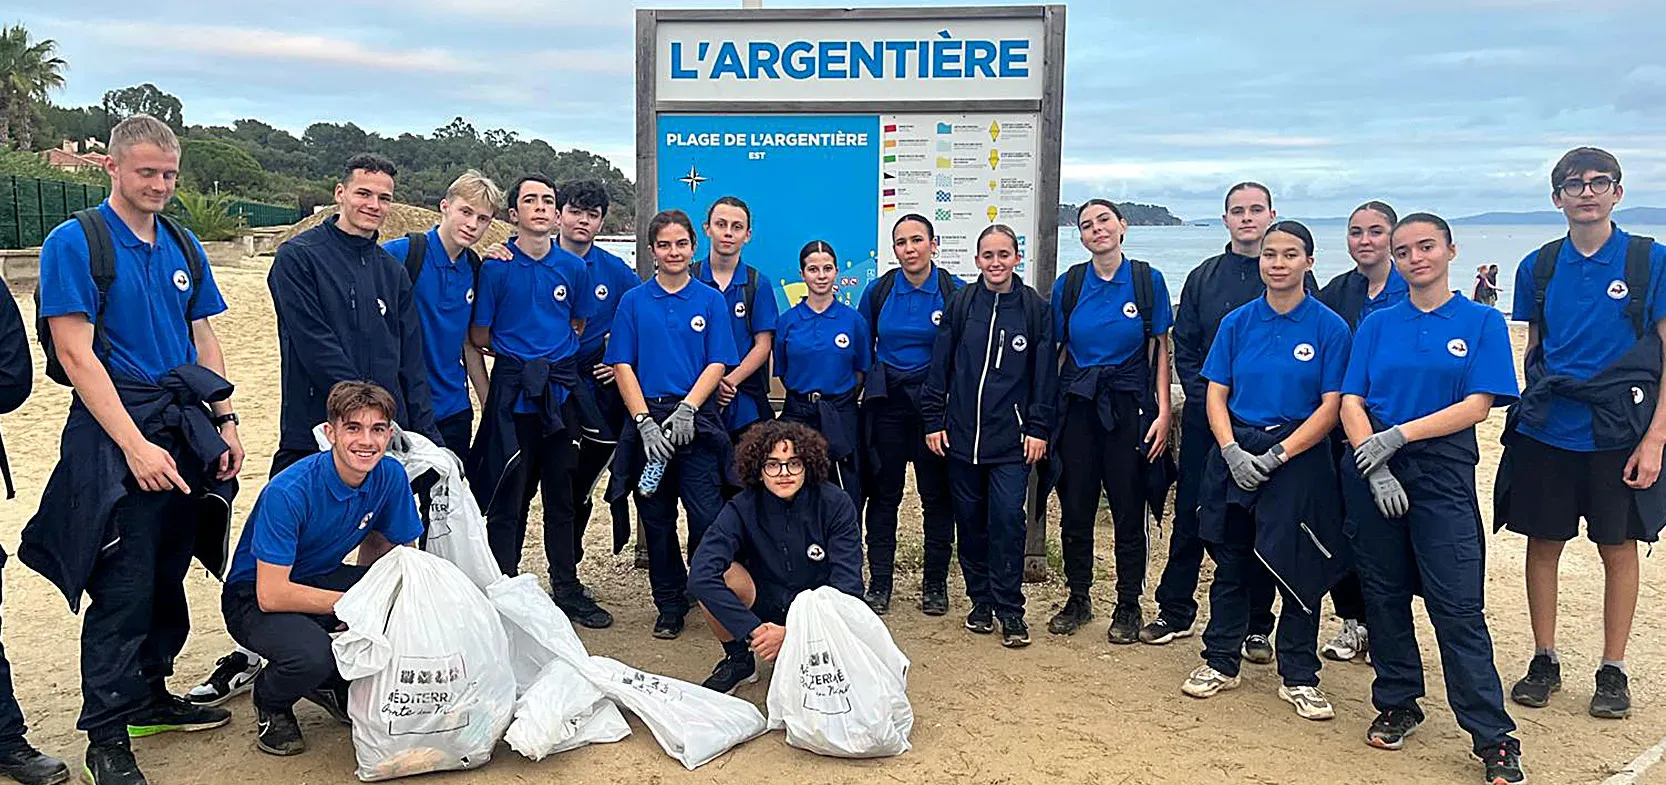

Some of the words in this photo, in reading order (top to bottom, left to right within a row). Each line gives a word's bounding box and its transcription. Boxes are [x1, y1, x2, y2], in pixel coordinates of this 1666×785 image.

[670, 30, 1030, 80] L'ARGENTIÈRE
[666, 133, 721, 147] PLAGE
[724, 133, 747, 147] DE
[750, 130, 868, 147] L'ARGENTIÈRE
[748, 151, 766, 160] EST
